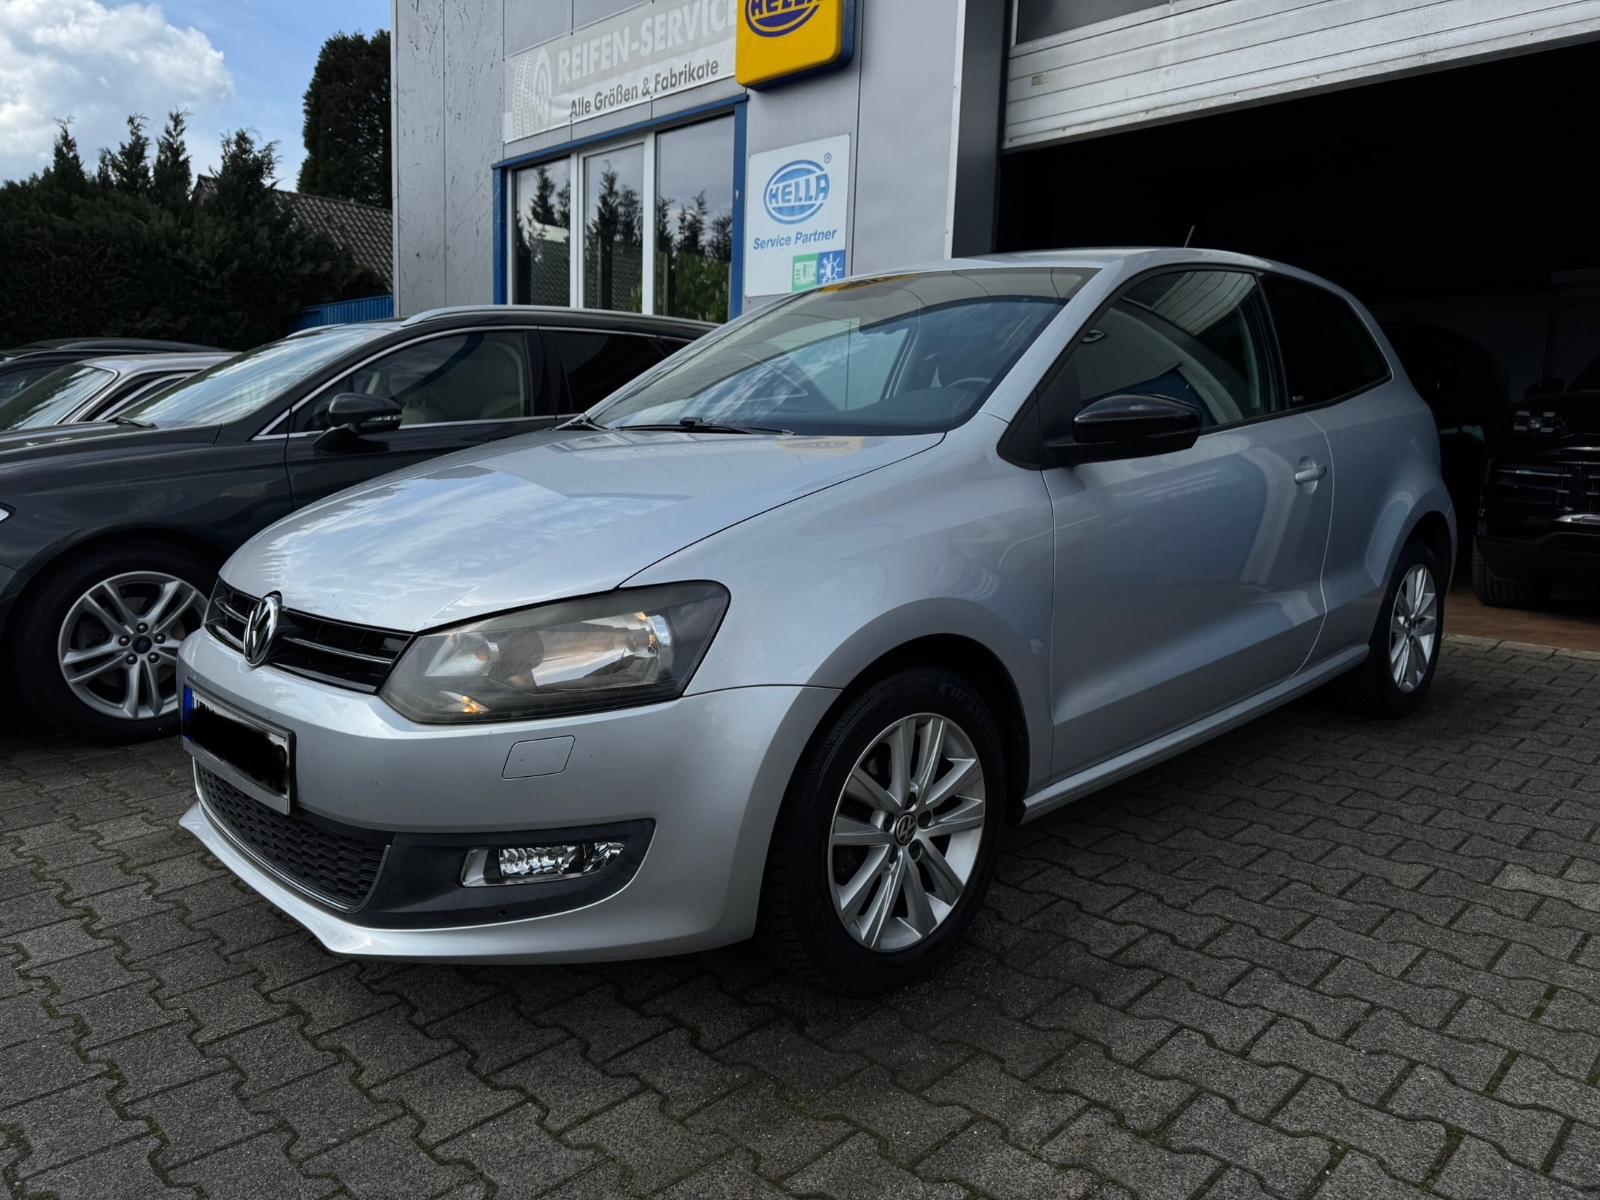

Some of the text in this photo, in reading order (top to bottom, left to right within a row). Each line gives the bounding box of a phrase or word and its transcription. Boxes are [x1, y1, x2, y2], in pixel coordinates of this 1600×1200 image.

[570, 60, 719, 117] Alle Größen & Fabrikate
[769, 173, 829, 205] HELLA
[753, 229, 838, 249] Service Partner
